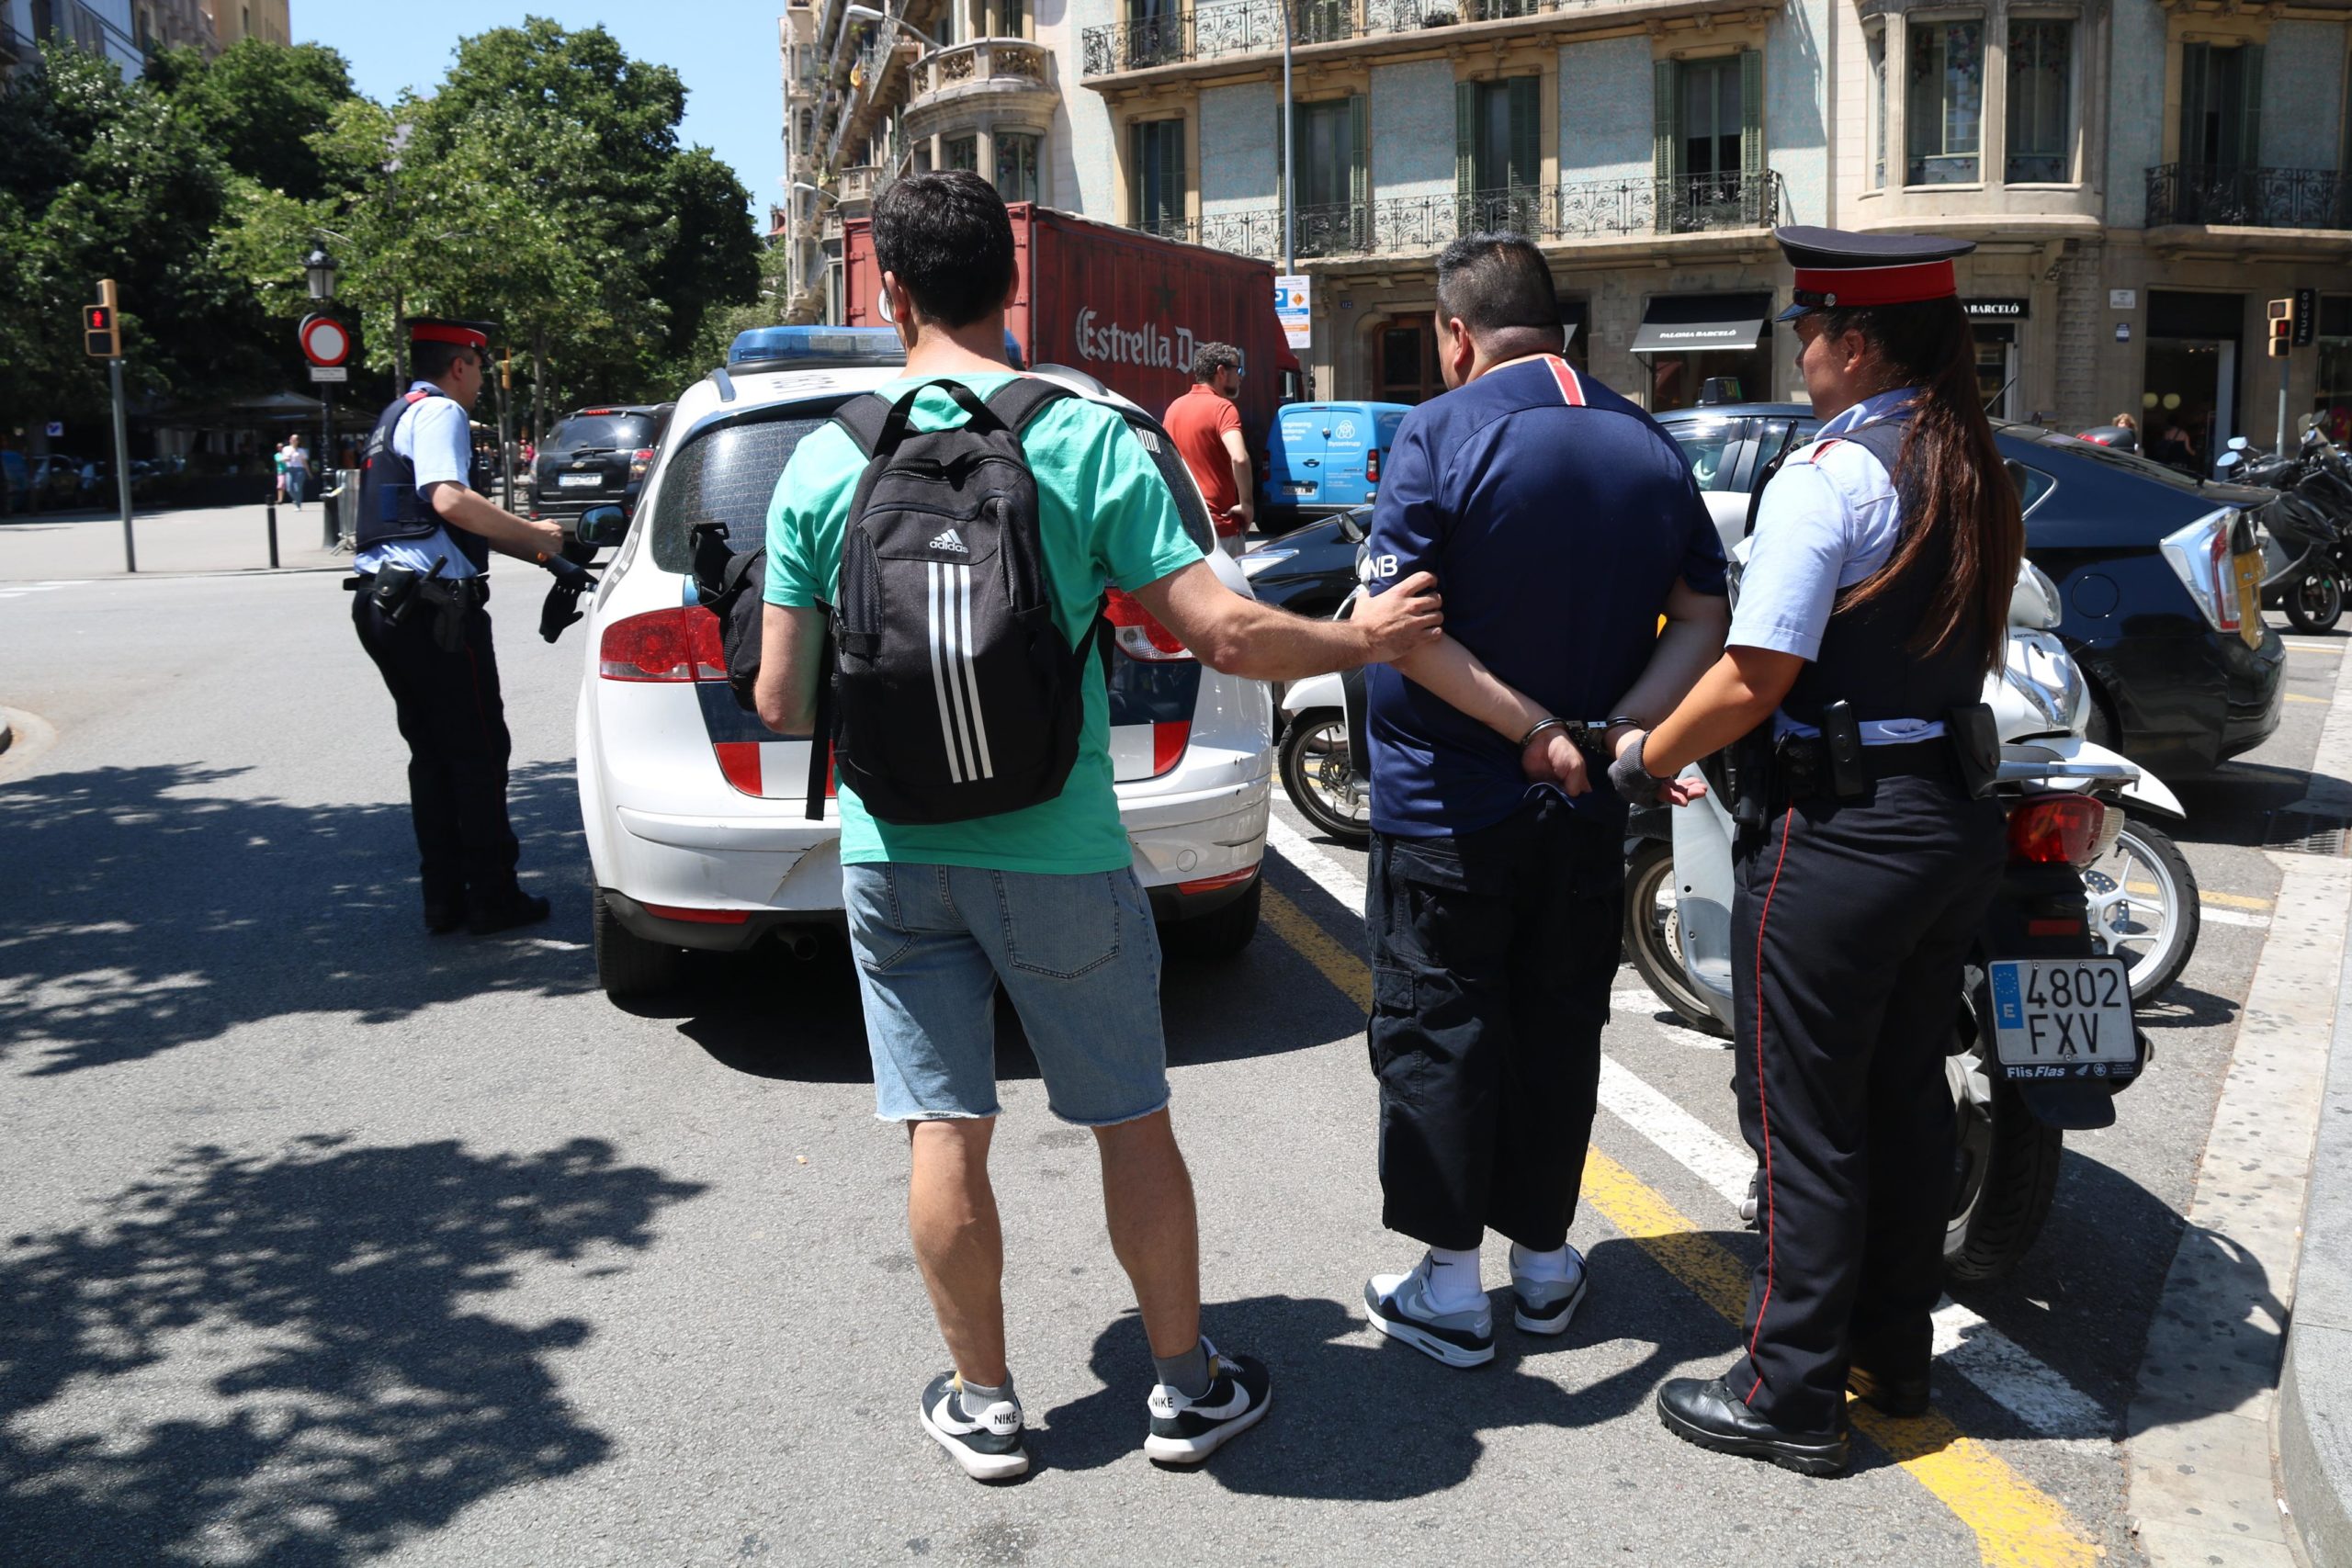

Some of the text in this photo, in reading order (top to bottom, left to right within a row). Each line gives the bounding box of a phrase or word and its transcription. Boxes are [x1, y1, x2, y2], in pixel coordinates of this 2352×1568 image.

[1970, 302, 2019, 313] BARCELÓ
[2299, 291, 2309, 343] TRUCCO
[1075, 306, 1172, 368] Estrella
[930, 540, 968, 553] adidas
[2027, 967, 2121, 1009] 4802
[2003, 1003, 2016, 1018] E
[2029, 1013, 2098, 1055] FXV
[1152, 1397, 1173, 1408] NIKE
[994, 1412, 1017, 1425] NIKE
